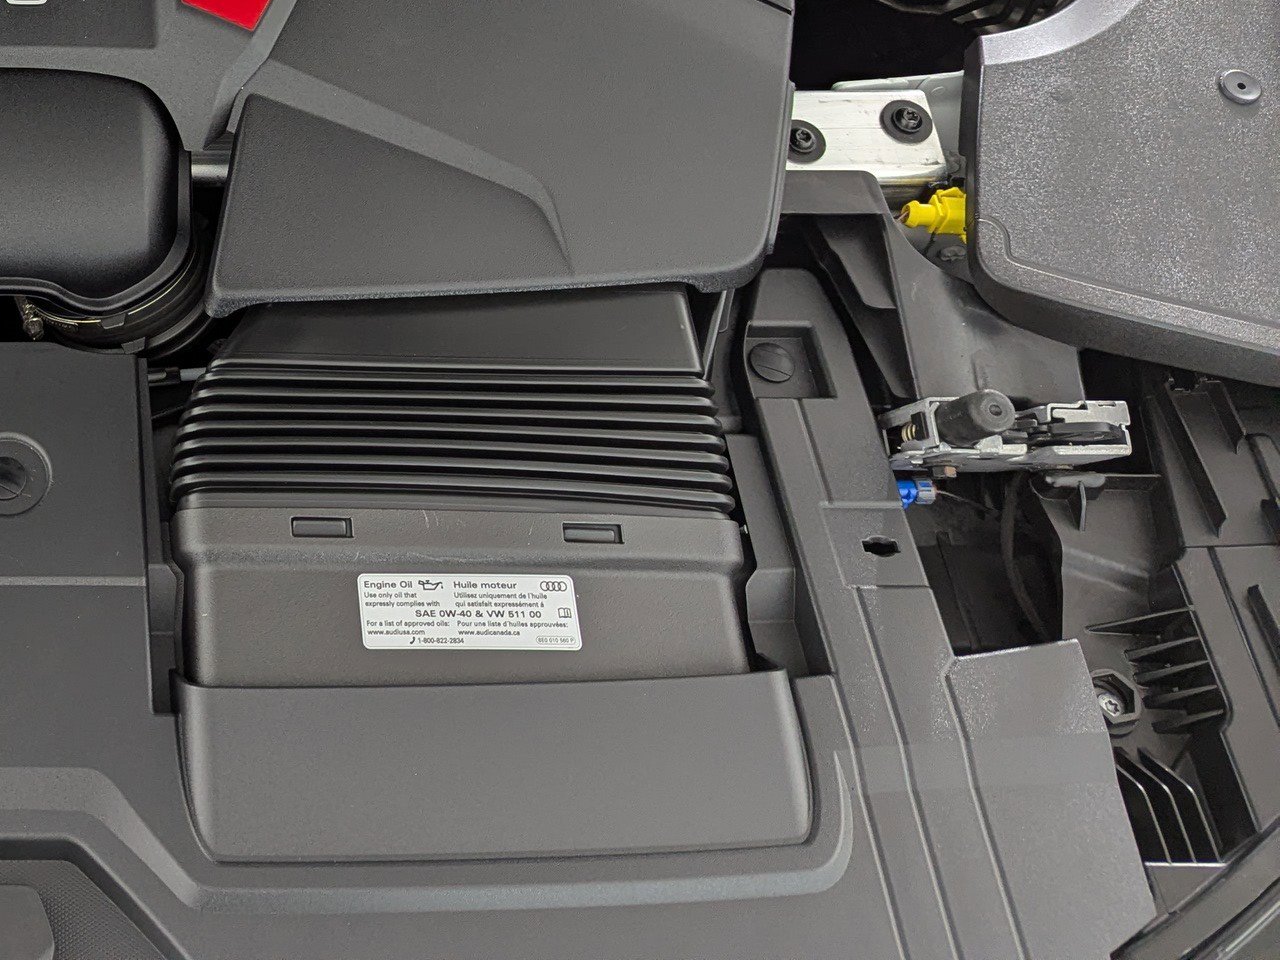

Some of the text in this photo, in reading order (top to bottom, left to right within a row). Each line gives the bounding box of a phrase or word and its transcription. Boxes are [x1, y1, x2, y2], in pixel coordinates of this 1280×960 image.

[363, 580, 413, 590] Engine Oil
[453, 581, 517, 589] Huile moteur
[478, 592, 517, 600] uniquement
[365, 600, 395, 608] expressly
[415, 610, 542, 618] SAE 0W-40 & VW 511 00
[404, 620, 435, 628] approved
[503, 620, 528, 628] d'huiles
[530, 621, 568, 629] approuvées:
